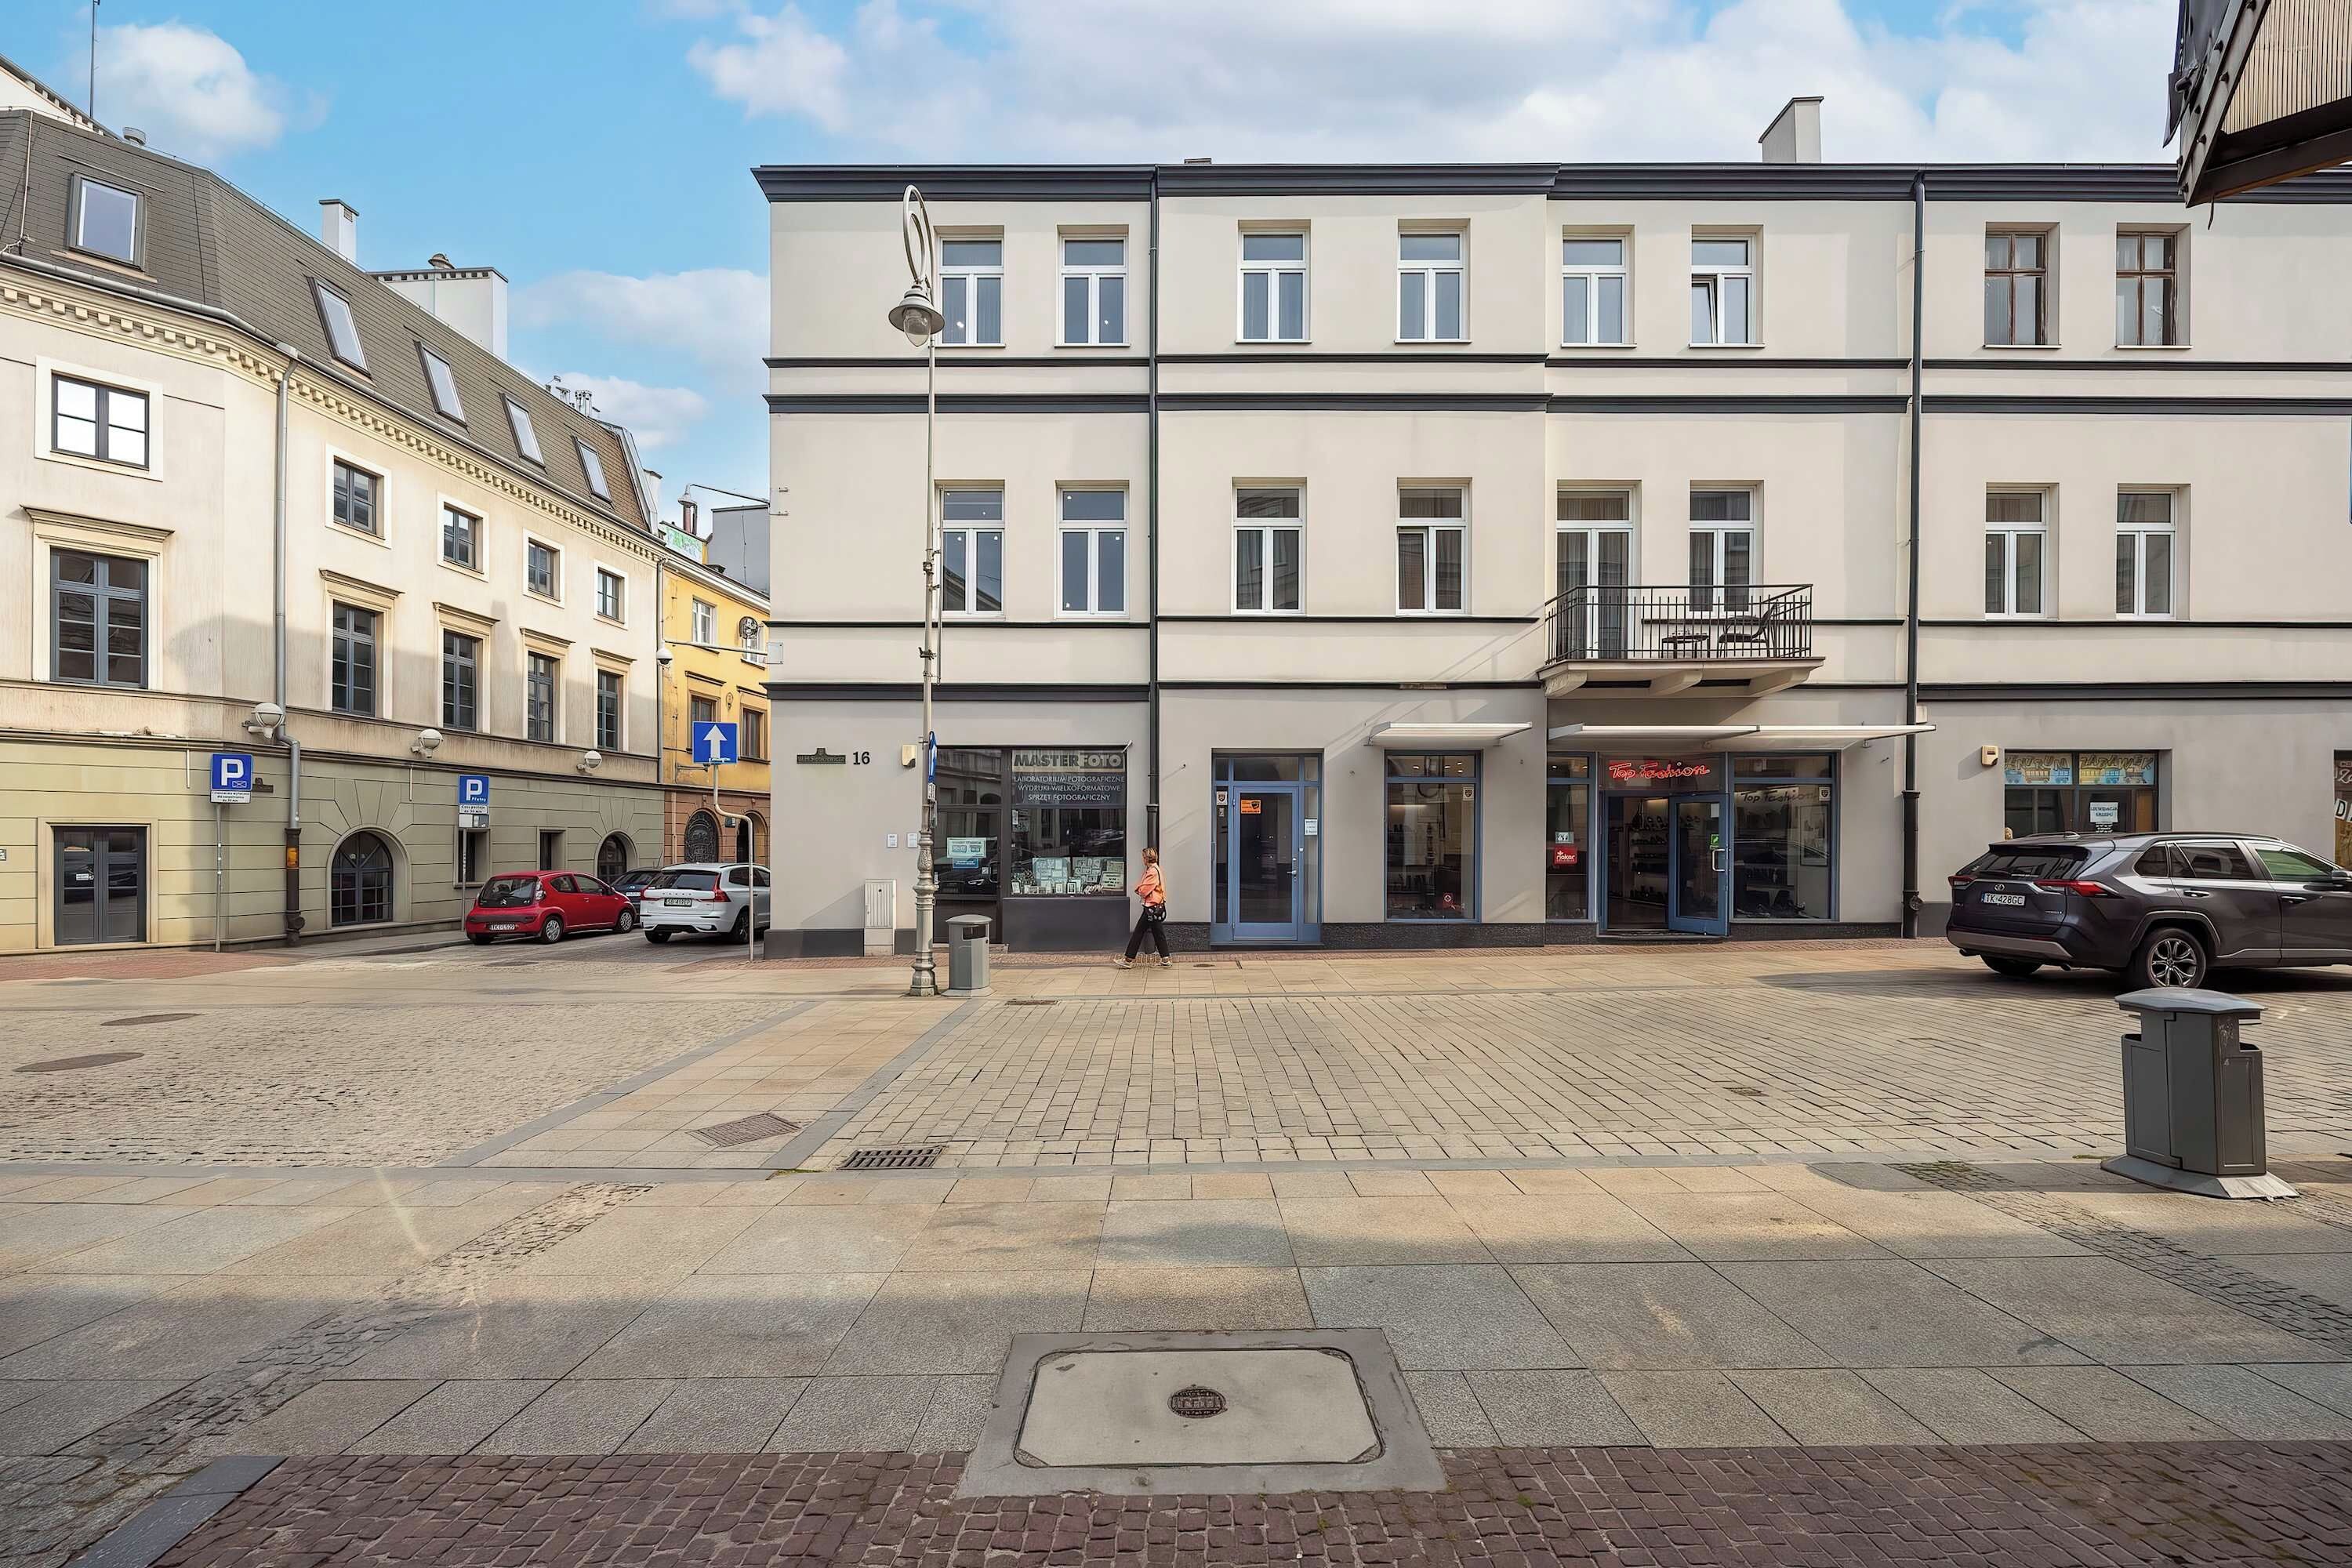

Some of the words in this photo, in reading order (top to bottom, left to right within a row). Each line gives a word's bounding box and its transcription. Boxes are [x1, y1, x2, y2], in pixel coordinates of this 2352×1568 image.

[853, 751, 870, 765] 16
[221, 758, 244, 786] P
[1610, 763, 1636, 781] Top
[1639, 761, 1710, 779] Fashion
[466, 779, 482, 800] P
[1985, 894, 1996, 903] TK
